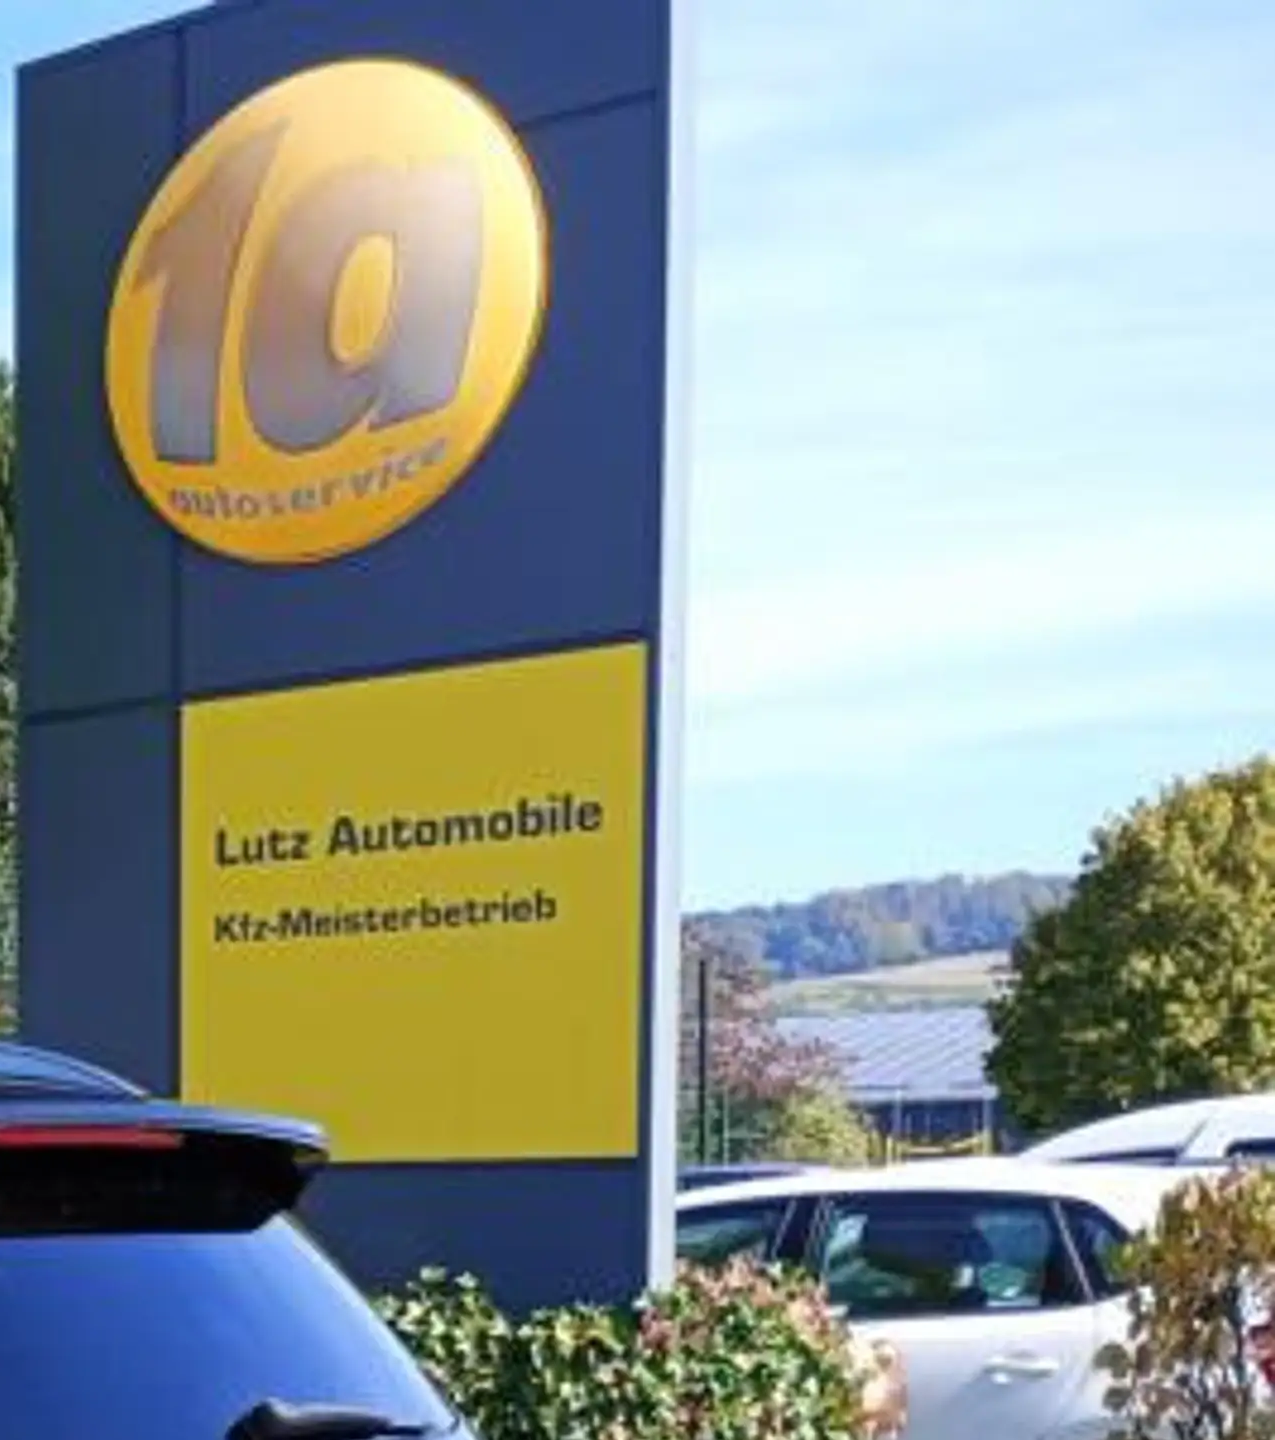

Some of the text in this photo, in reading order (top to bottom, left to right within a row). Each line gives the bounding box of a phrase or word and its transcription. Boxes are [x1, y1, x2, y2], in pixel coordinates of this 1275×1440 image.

[170, 436, 448, 519] autoservice
[215, 793, 603, 868] Lutz Automobile
[214, 889, 558, 943] Kfz-Meisterbetrieb
